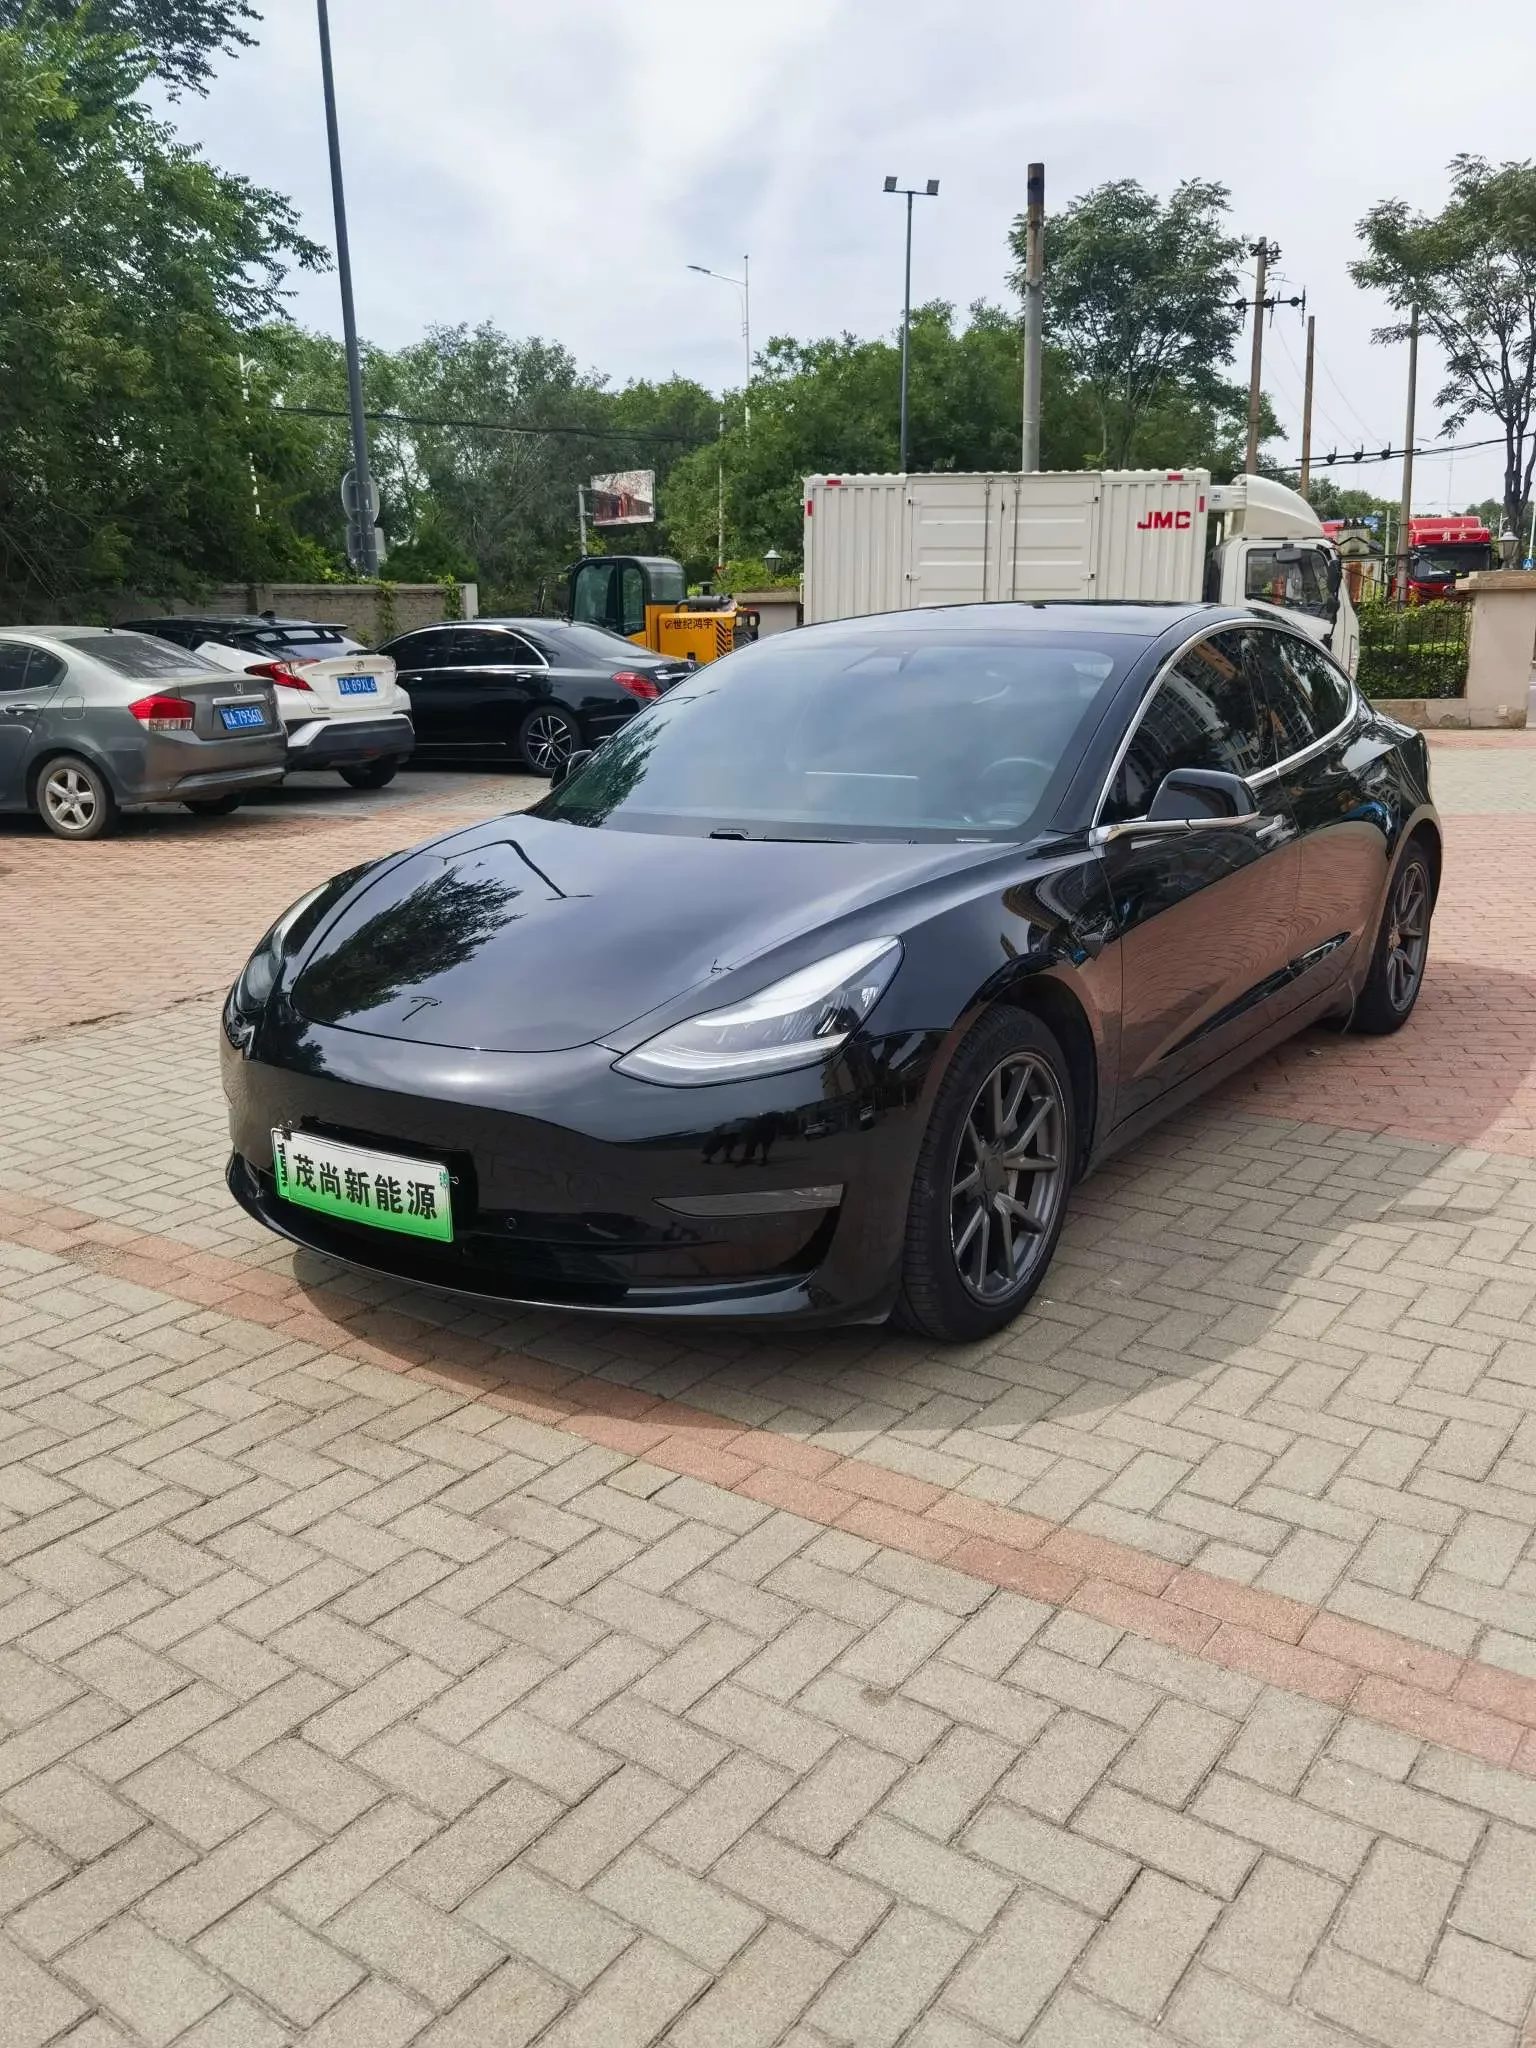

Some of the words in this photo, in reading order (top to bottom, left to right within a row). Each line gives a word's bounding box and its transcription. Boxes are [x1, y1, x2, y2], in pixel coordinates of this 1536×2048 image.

[1137, 511, 1191, 529] JMC
[293, 1153, 438, 1220] 茂尚新能源
